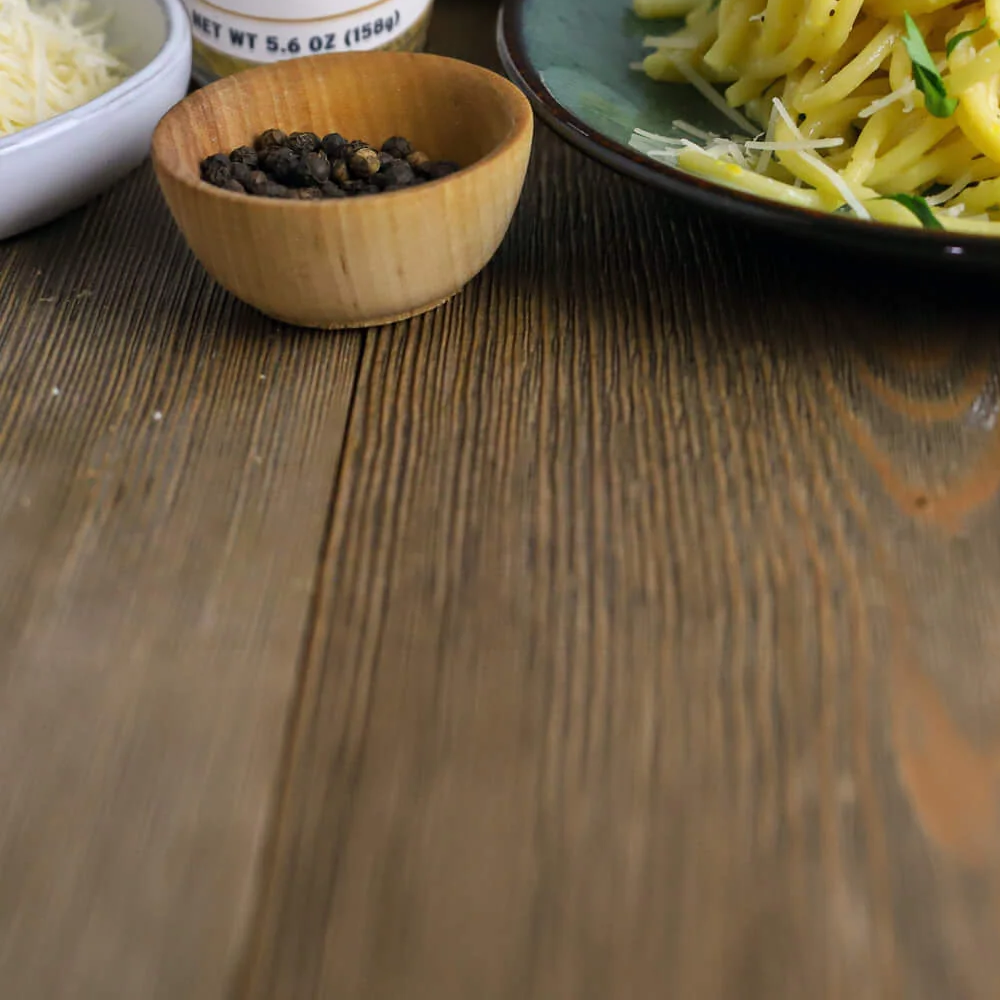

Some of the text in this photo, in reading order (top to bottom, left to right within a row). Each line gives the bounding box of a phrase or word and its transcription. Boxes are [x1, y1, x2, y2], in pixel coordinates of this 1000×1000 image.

[192, 9, 400, 53] NET WT 5.6 OZ (158g)
